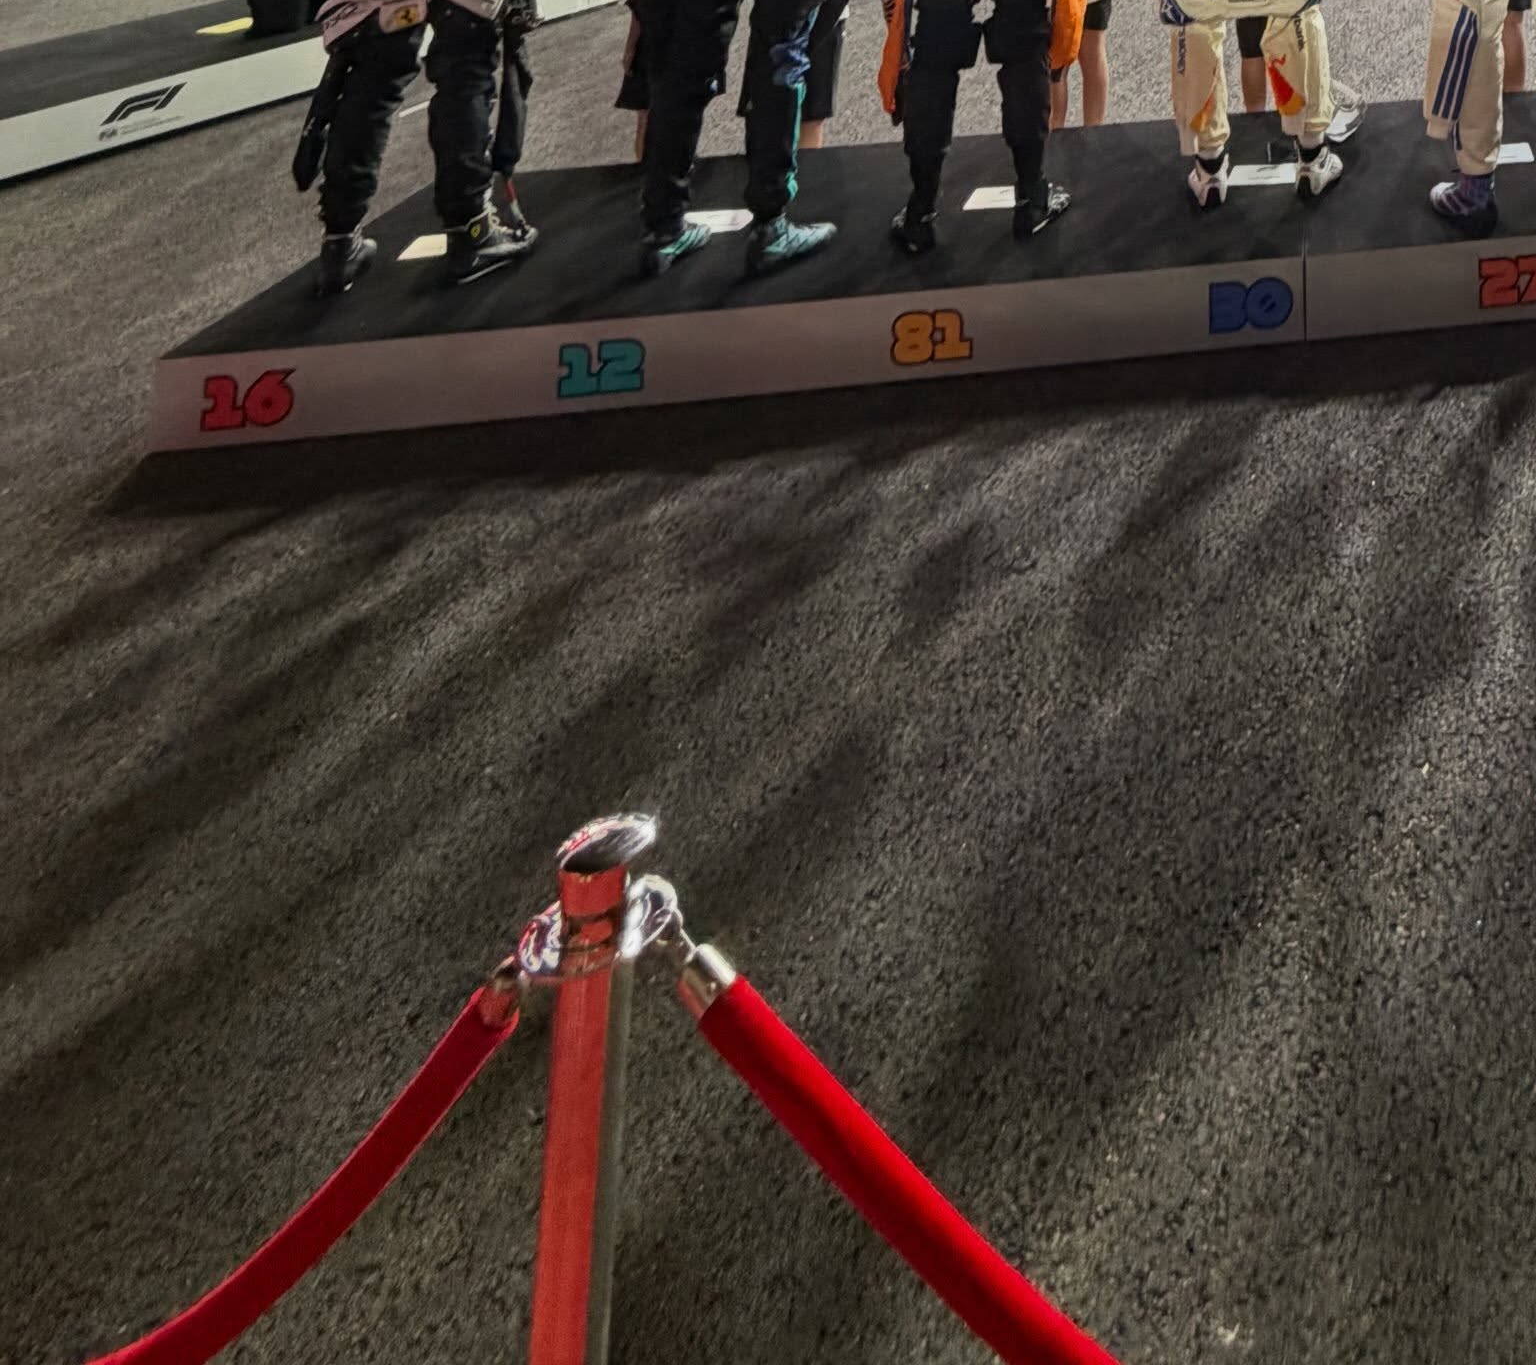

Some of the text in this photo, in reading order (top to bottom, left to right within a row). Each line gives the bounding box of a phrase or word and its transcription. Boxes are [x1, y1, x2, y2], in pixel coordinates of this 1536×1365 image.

[890, 308, 973, 365] 81
[557, 338, 646, 398] 12
[201, 369, 297, 432] 16
